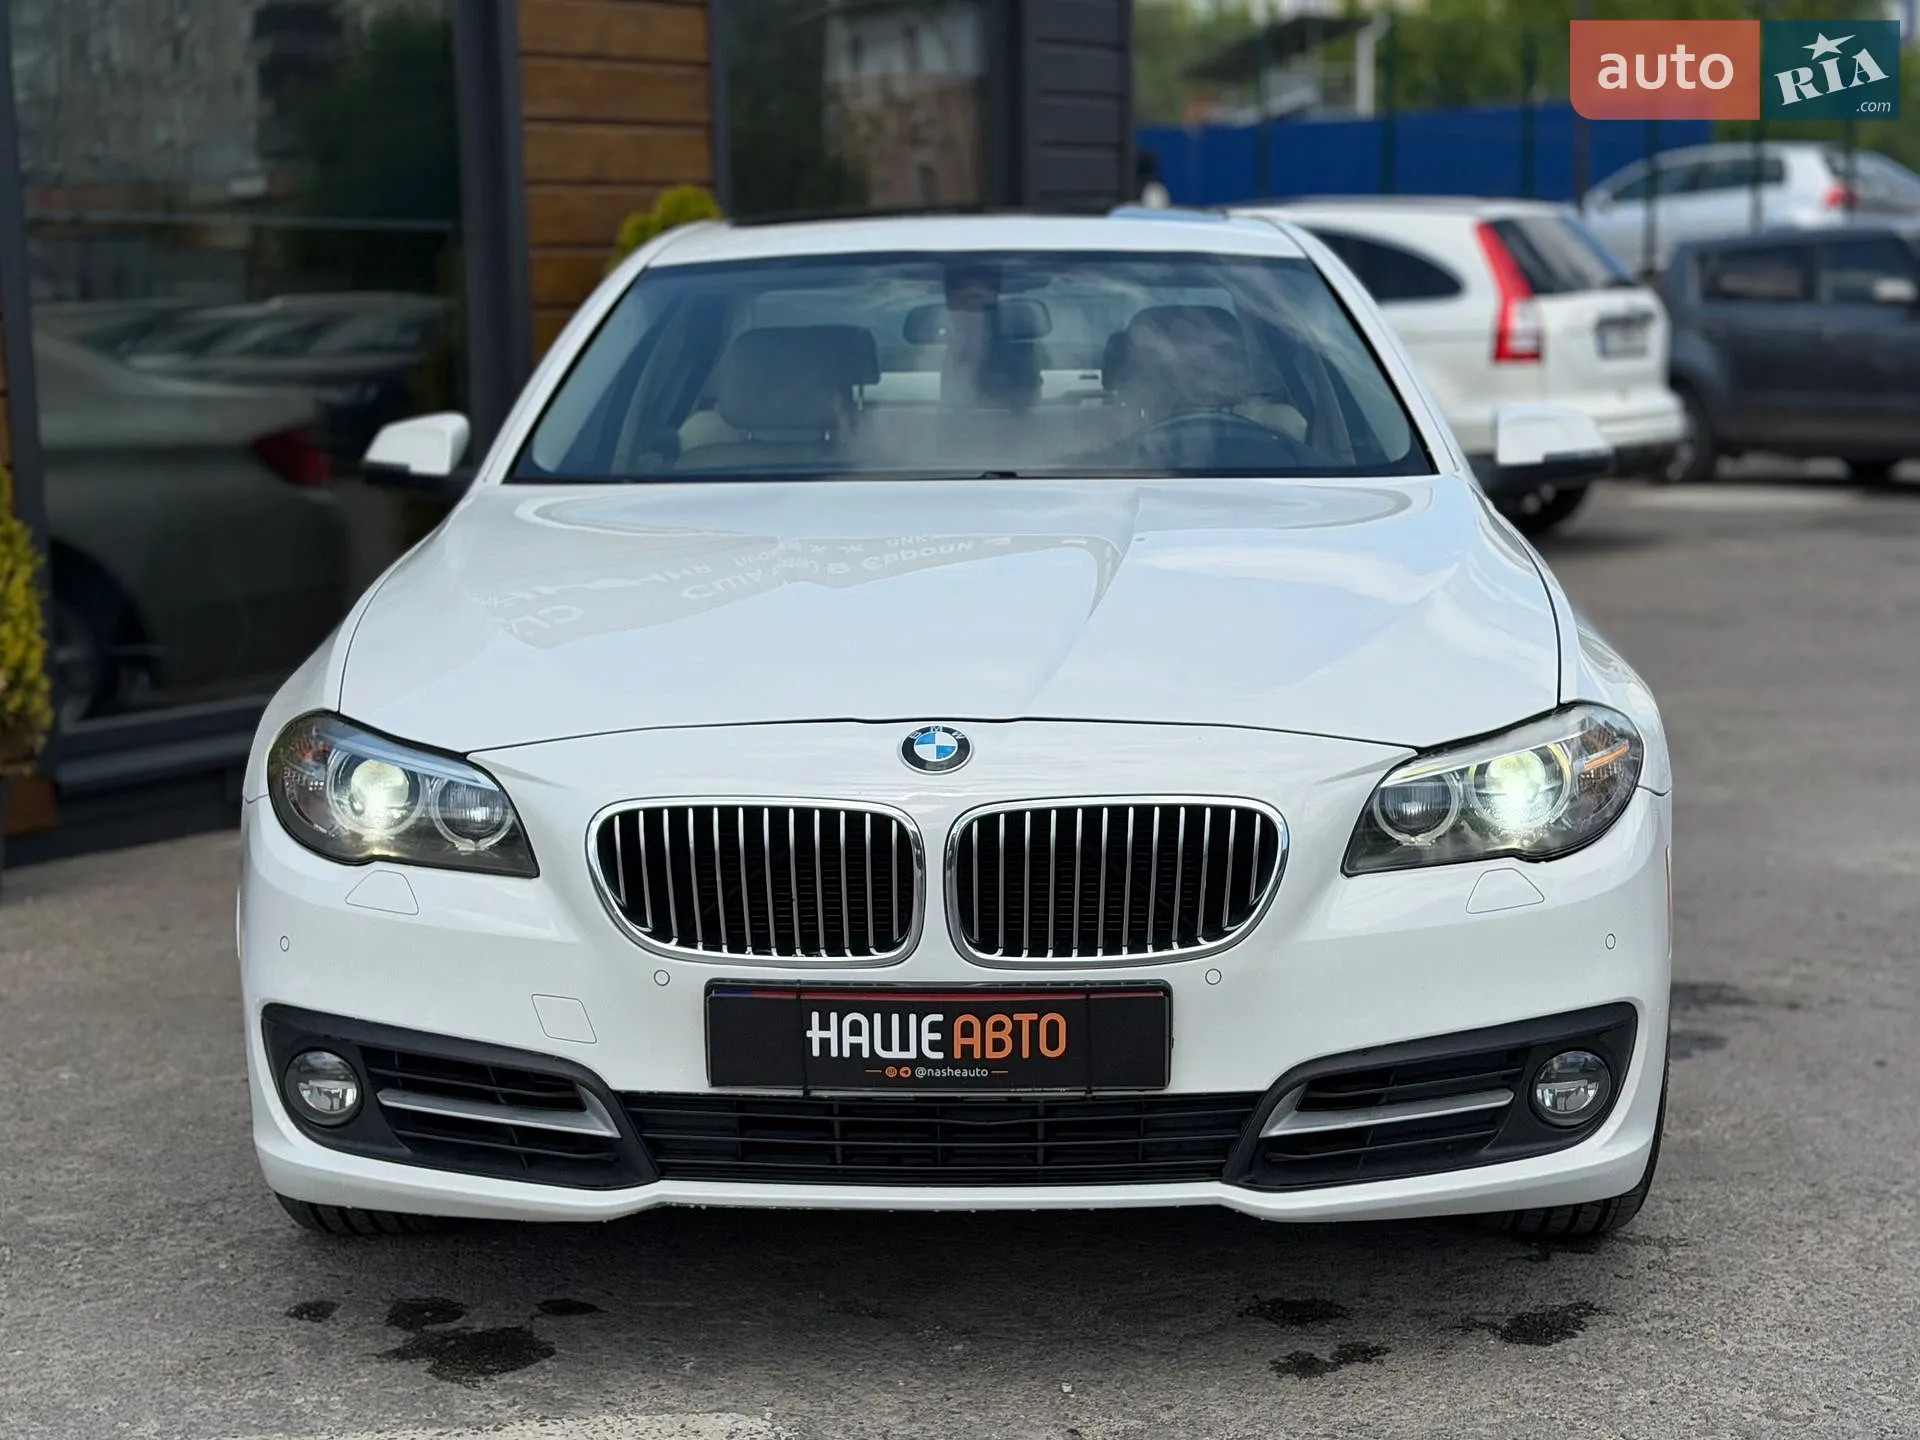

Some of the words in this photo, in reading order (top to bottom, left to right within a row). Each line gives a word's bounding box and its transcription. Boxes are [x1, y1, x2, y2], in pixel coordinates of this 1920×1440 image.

[806, 1011, 945, 1060] НАШЕ
[953, 1012, 1067, 1060] АВТО
[914, 1066, 989, 1078] @nasheauto
